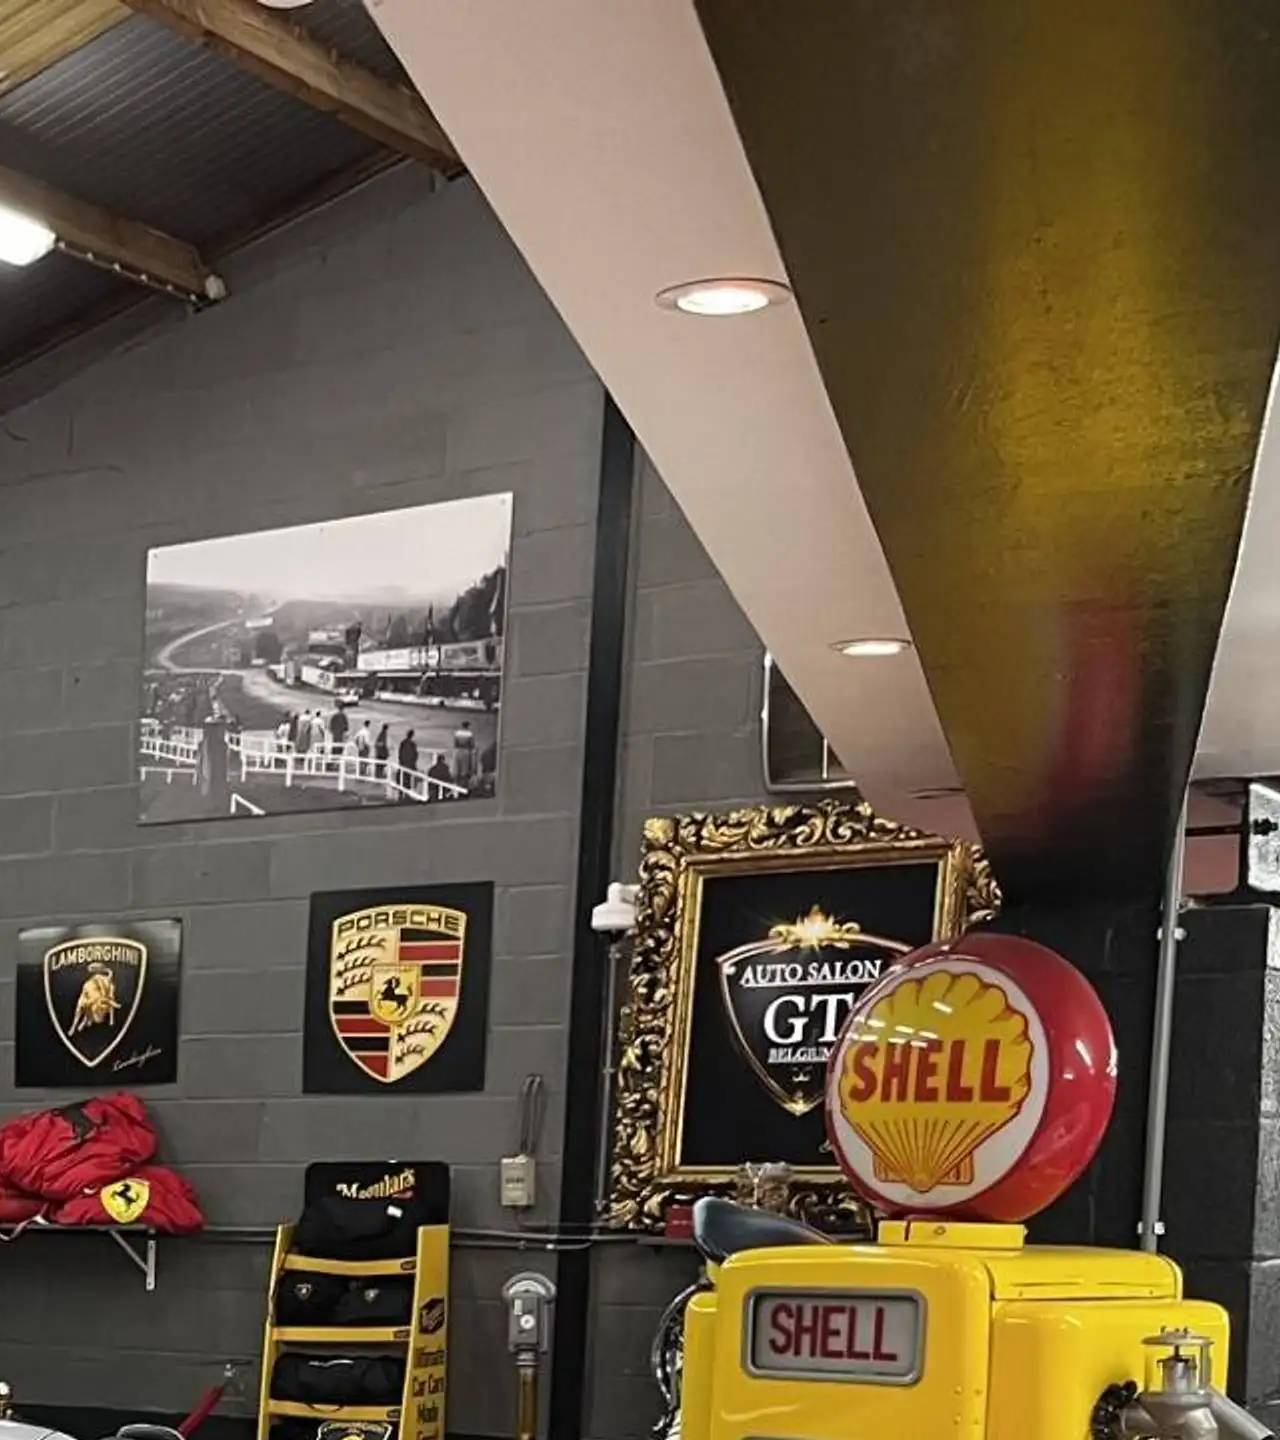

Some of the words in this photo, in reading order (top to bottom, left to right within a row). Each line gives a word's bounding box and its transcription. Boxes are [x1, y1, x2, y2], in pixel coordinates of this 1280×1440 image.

[338, 909, 461, 938] PORSCHE
[51, 944, 139, 970] LAMBORGHINI
[740, 963, 806, 985] AUTO
[807, 960, 883, 982] SALON
[763, 993, 854, 1044] GT
[848, 1039, 1011, 1103] SHELL
[768, 1302, 898, 1362] SHELL
